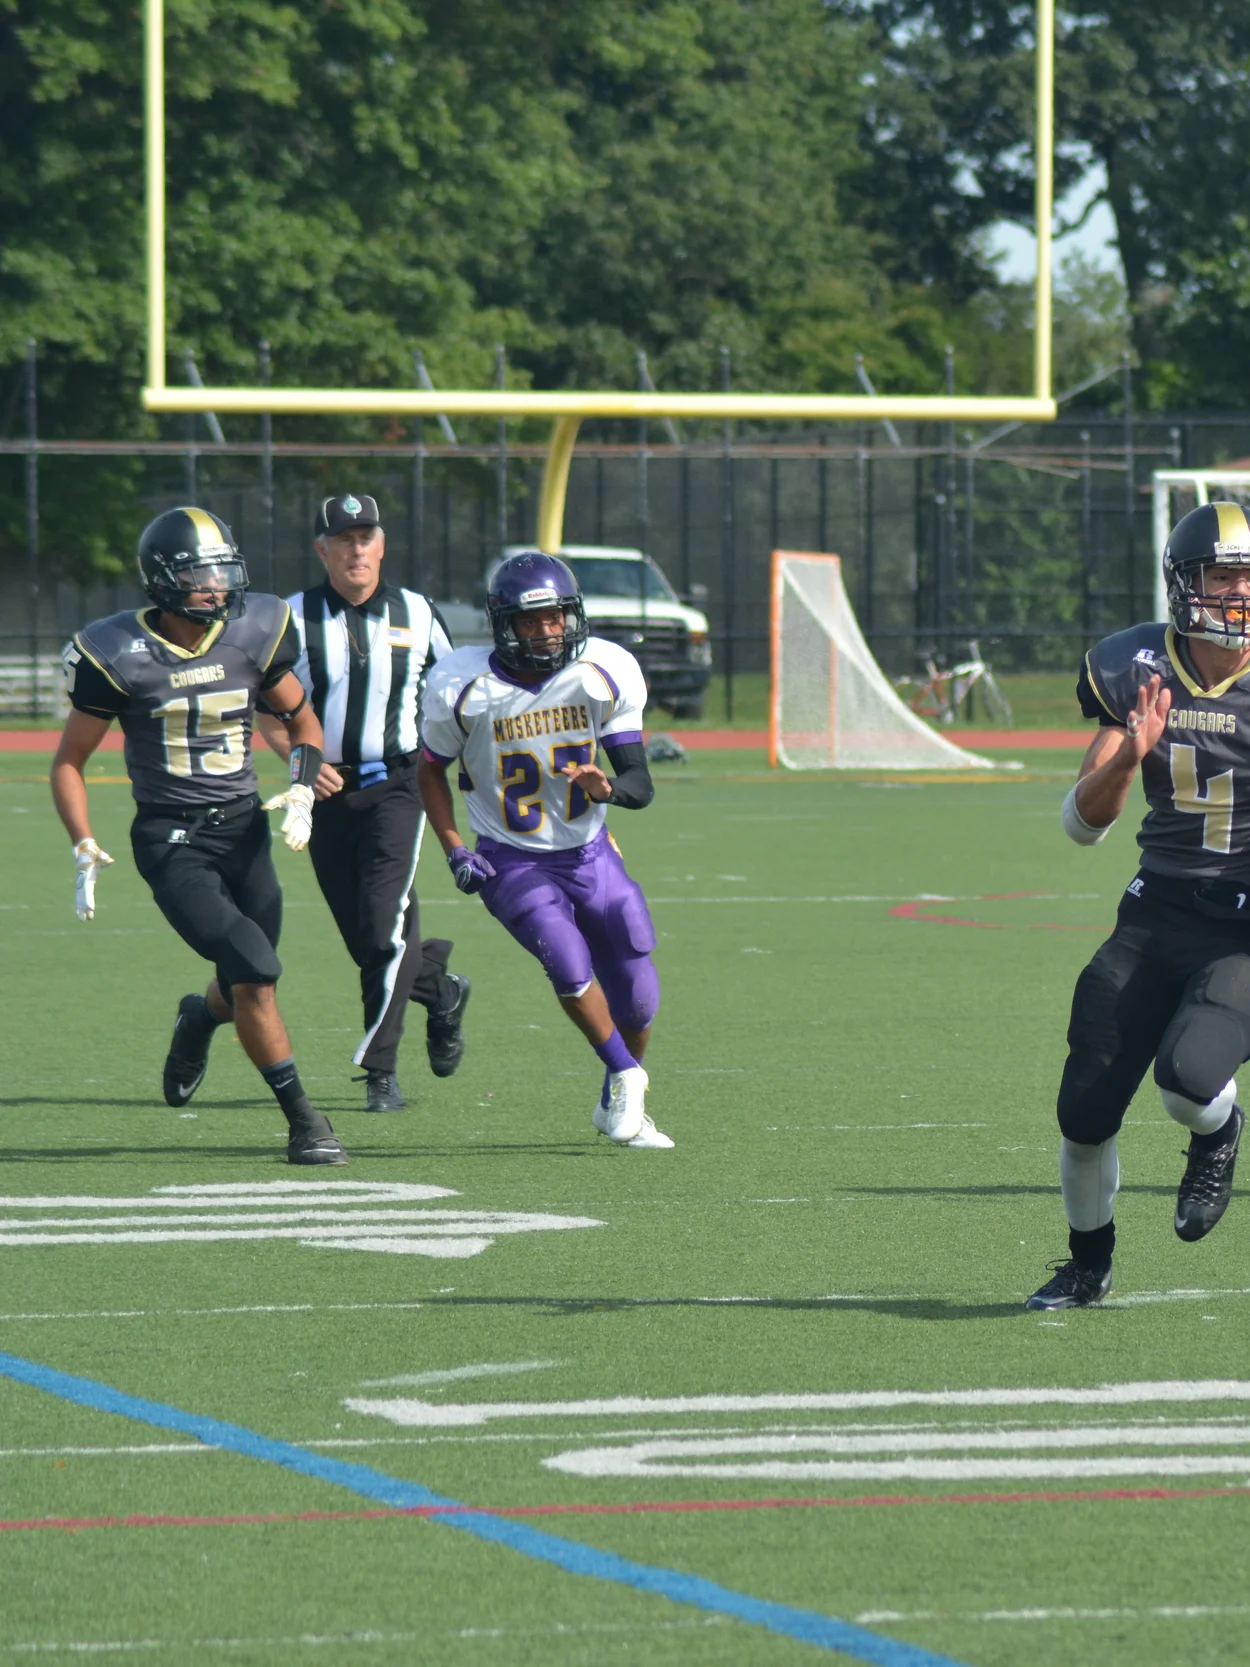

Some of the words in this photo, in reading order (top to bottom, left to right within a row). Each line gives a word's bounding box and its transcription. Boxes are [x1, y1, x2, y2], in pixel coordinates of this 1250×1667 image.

[169, 664, 225, 689] COUGARS
[152, 688, 249, 777] 15
[493, 705, 589, 743] MUSKETEERS
[1167, 708, 1236, 734] COUGARS
[499, 739, 596, 835] 27
[1170, 742, 1234, 854] 4
